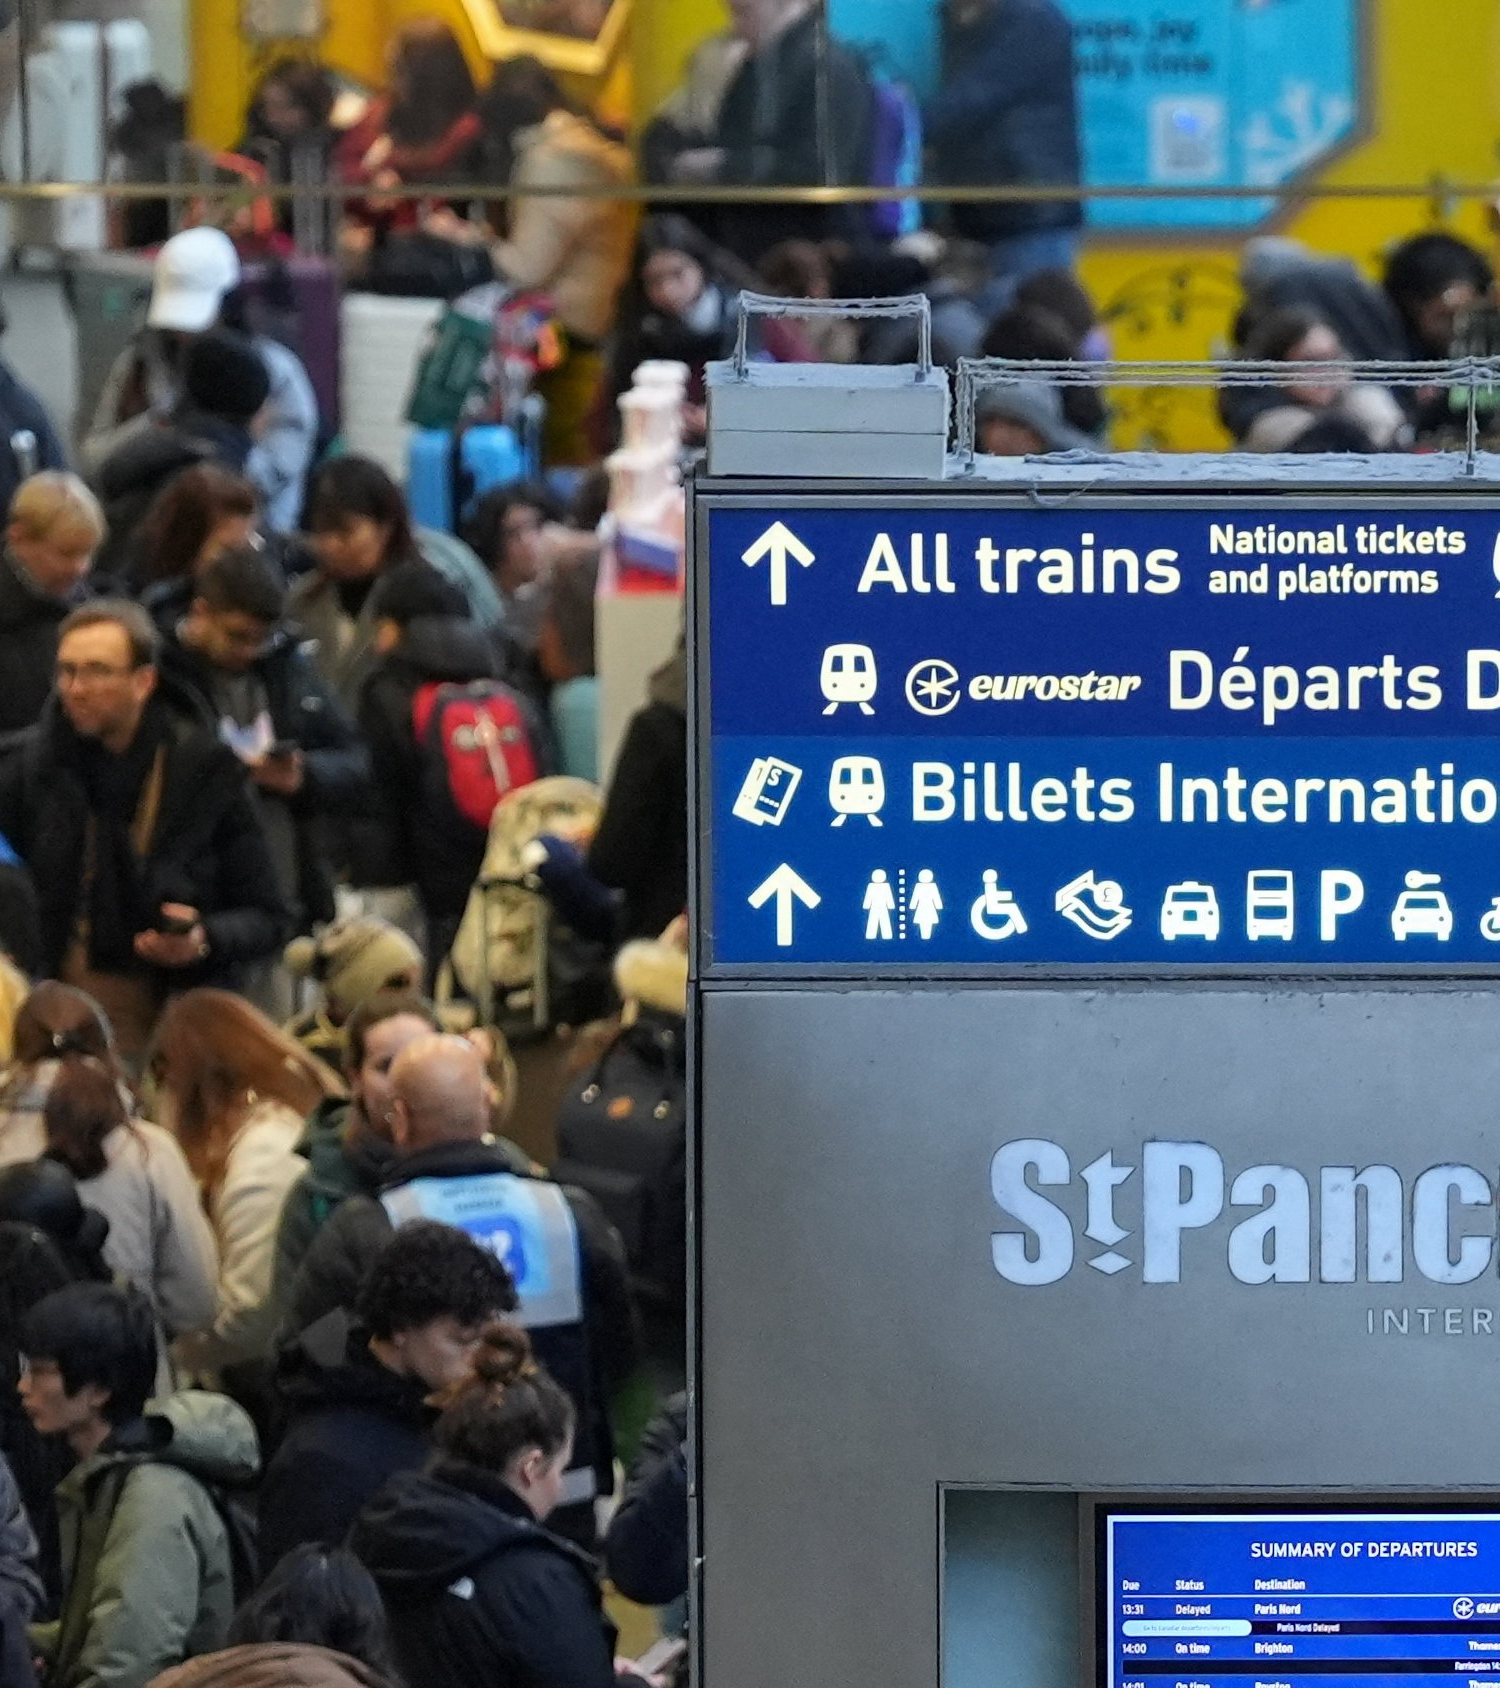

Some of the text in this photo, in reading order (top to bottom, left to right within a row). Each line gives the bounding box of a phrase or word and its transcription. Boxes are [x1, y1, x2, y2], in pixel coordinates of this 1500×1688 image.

[1209, 524, 1467, 555] National tickets
[857, 533, 1181, 594] All trains
[1208, 563, 1439, 601] and platforms
[968, 669, 1142, 702] eurostar
[1169, 646, 1442, 721] Départs
[912, 763, 1135, 823] Billets
[1251, 1541, 1478, 1558] SUMMARY OF DEPARTURES
[1122, 1579, 1140, 1591] Due
[1175, 1579, 1205, 1591] Status
[1254, 1578, 1306, 1591] Destination
[1122, 1604, 1144, 1615] 13:31
[1175, 1604, 1211, 1617] Delayed
[1254, 1604, 1278, 1615] Paris
[1278, 1604, 1302, 1615] Nord
[1122, 1643, 1148, 1654] 14:00
[1176, 1643, 1188, 1654] On
[1189, 1643, 1211, 1654] time
[1254, 1643, 1294, 1656] Brighton
